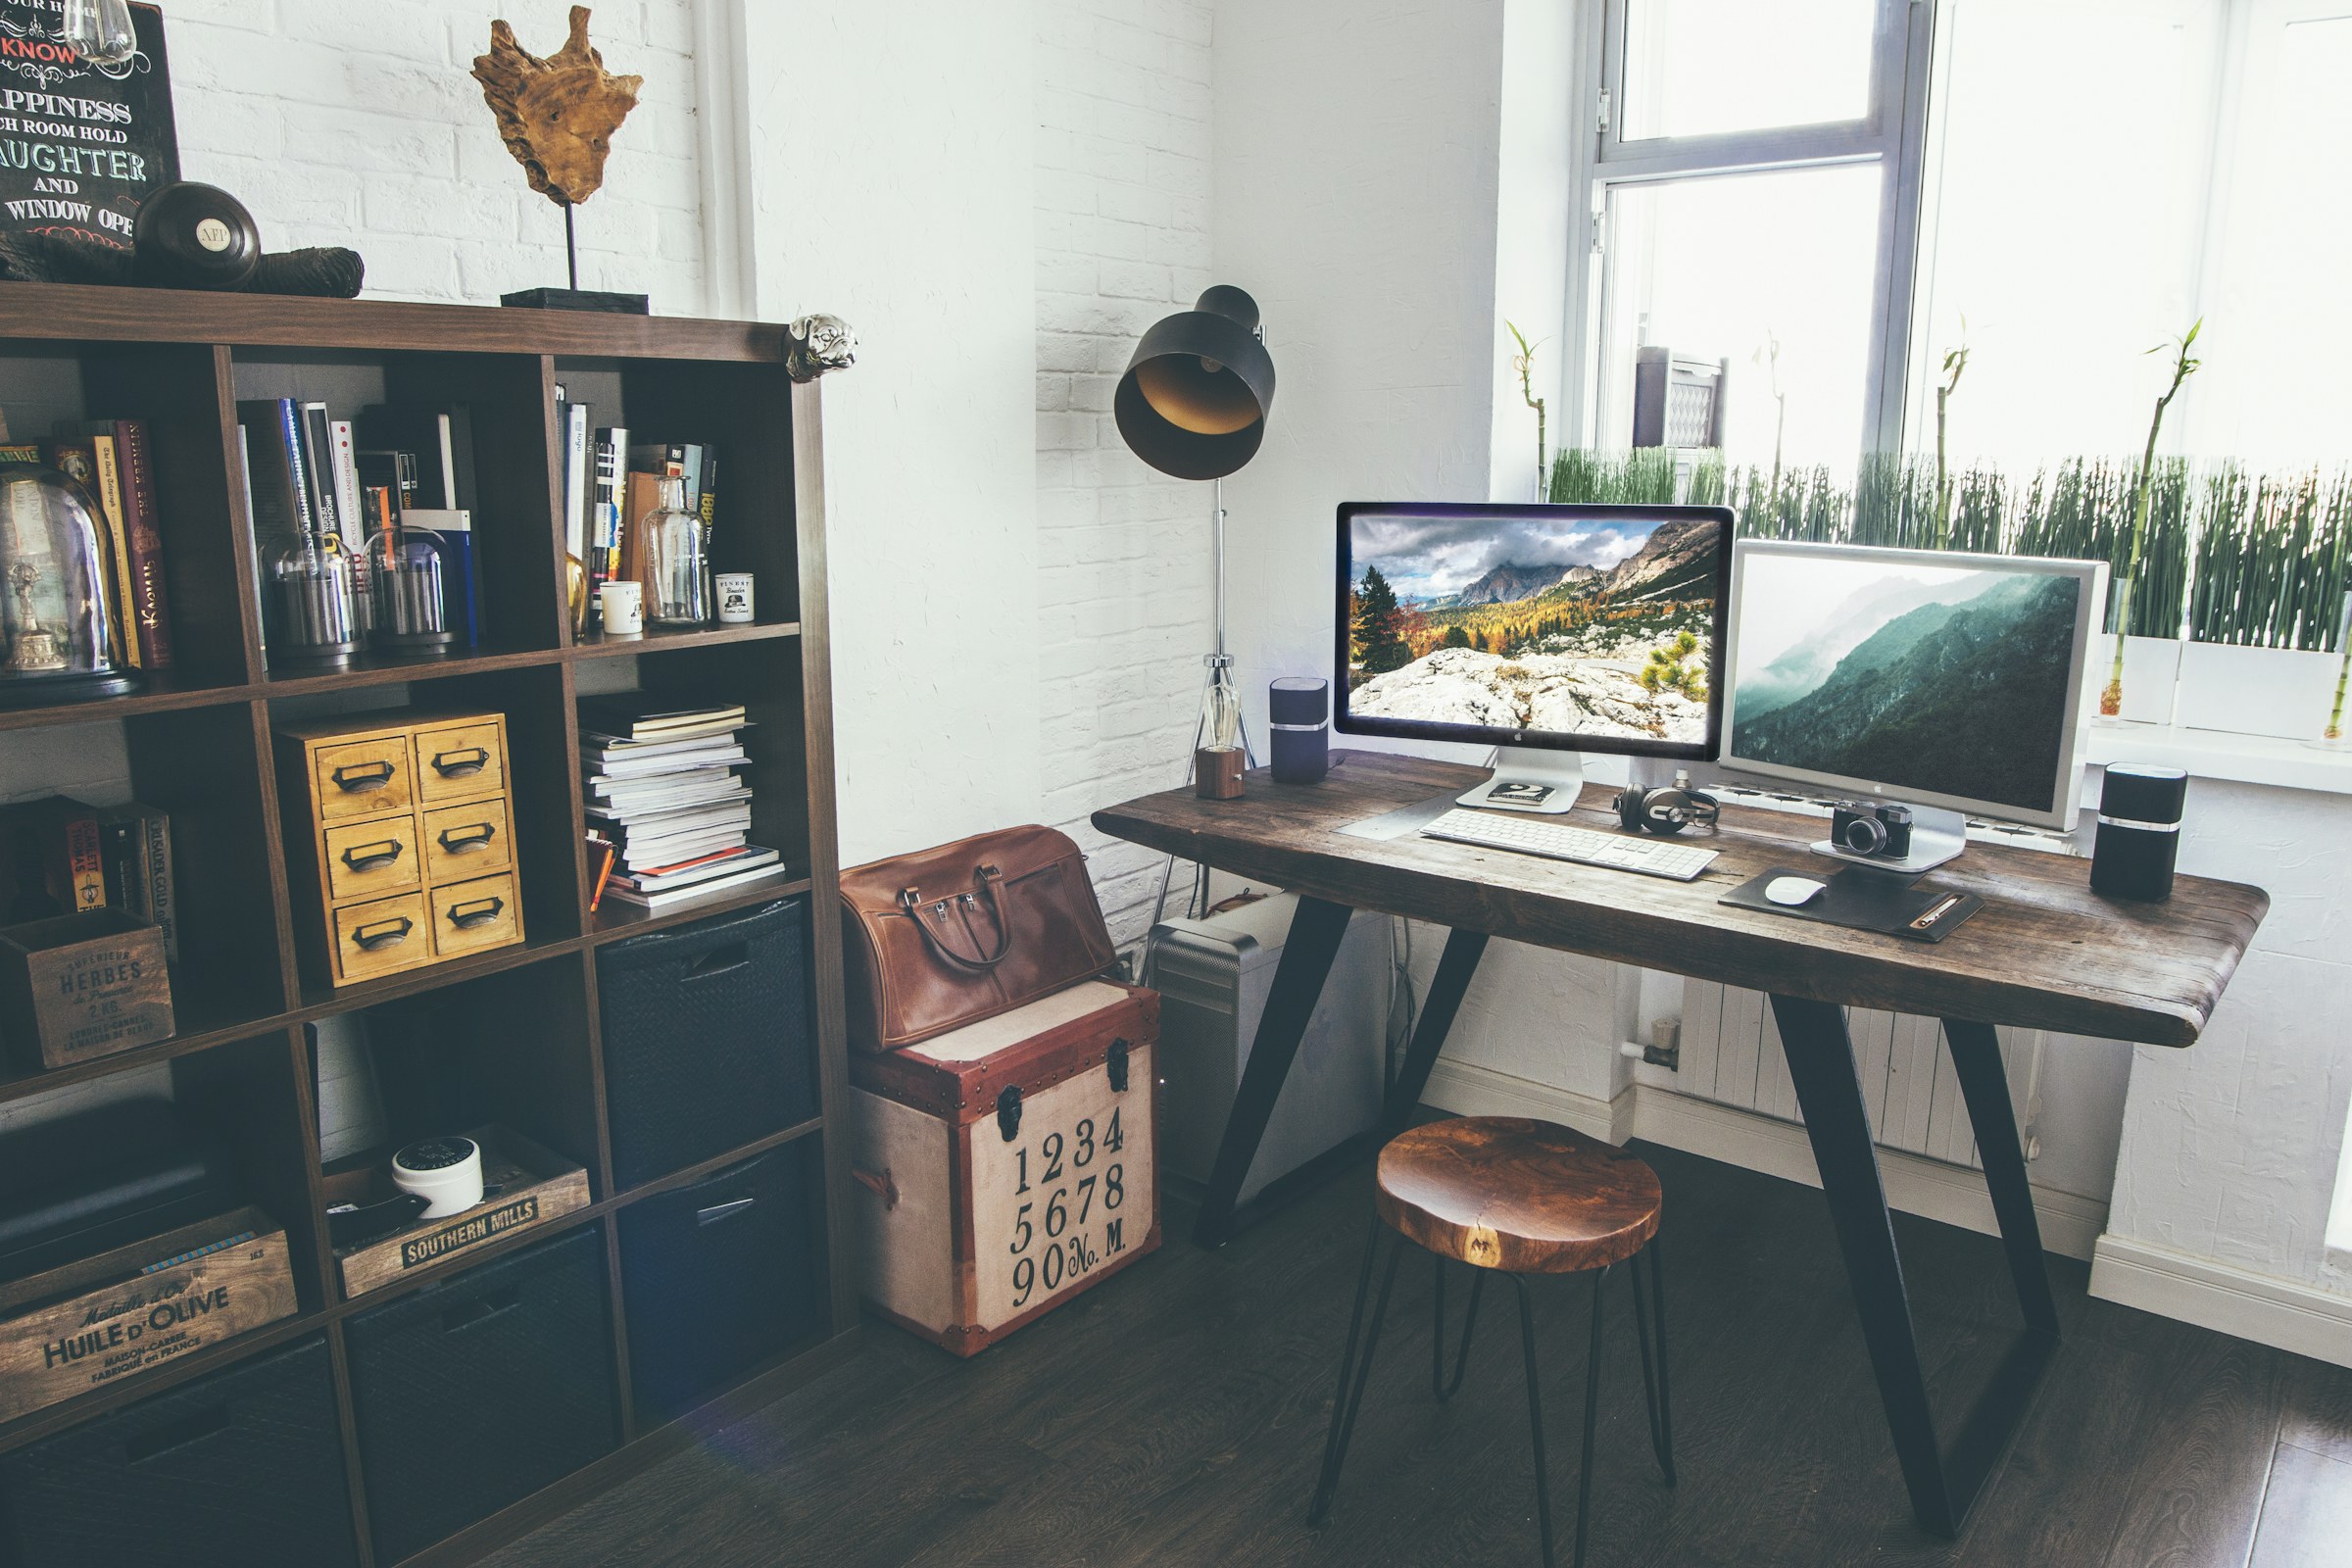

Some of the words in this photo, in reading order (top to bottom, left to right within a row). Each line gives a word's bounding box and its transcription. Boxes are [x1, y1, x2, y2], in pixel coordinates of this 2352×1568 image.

[1, 36, 79, 65] KNOW
[0, 89, 132, 124] PPINESS
[24, 122, 76, 138] ROOM
[79, 125, 127, 144] HOLD
[33, 177, 78, 195] AND
[5, 199, 92, 223] WINDOW
[324, 495, 336, 531] BROCHURE
[349, 521, 358, 546] BICYCLE
[72, 832, 85, 873] THOMAS
[83, 823, 98, 872] SCARLETT
[156, 877, 167, 906] GOLD
[61, 961, 141, 995] HERBES
[89, 1004, 97, 1017] 2
[408, 1218, 487, 1263] SOUTHERN
[491, 1201, 534, 1233] MILLS
[44, 1324, 123, 1369] HUILE
[161, 1337, 201, 1358] FRANCE
